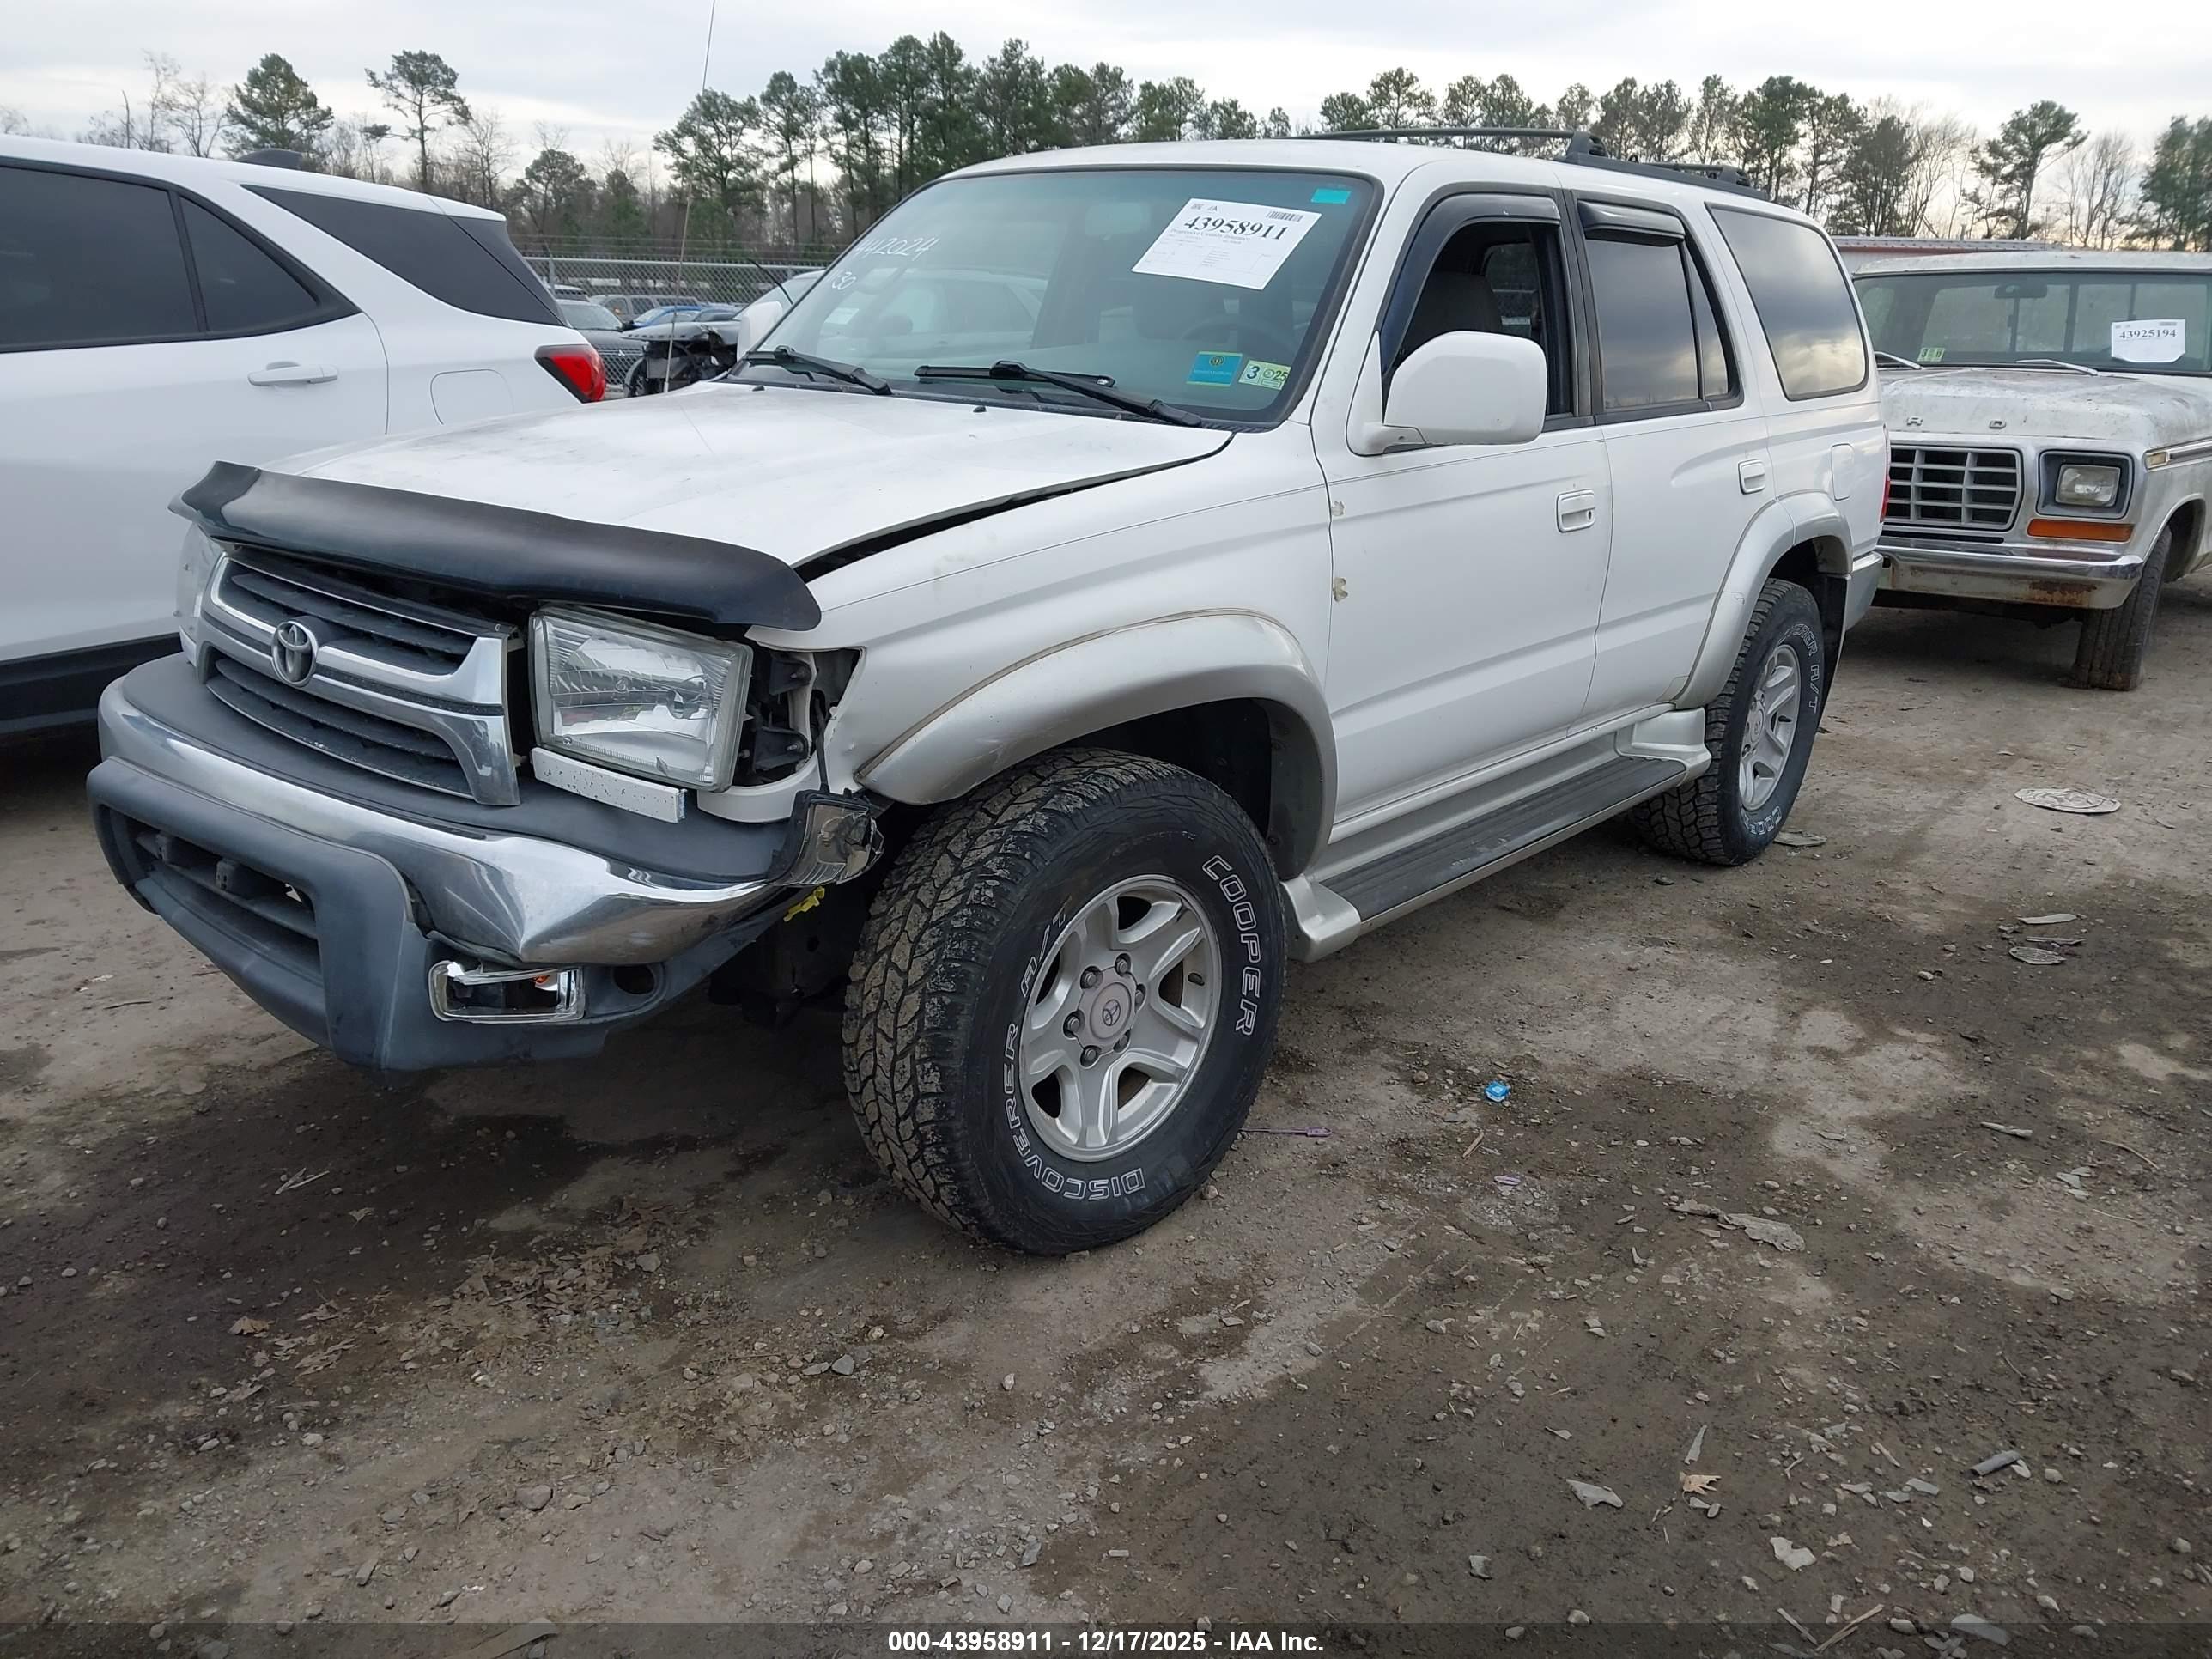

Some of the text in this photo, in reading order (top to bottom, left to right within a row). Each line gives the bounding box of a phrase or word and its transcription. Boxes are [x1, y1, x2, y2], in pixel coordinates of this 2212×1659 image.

[1184, 216, 1288, 240] 43958911
[2118, 329, 2177, 338] 43925194
[1247, 366, 1260, 380] 3
[1273, 370, 1288, 382] 25
[1906, 416, 2007, 430] RD
[1201, 854, 1261, 1036] COOPER
[1002, 1022, 1146, 1200] DISCOVERER
